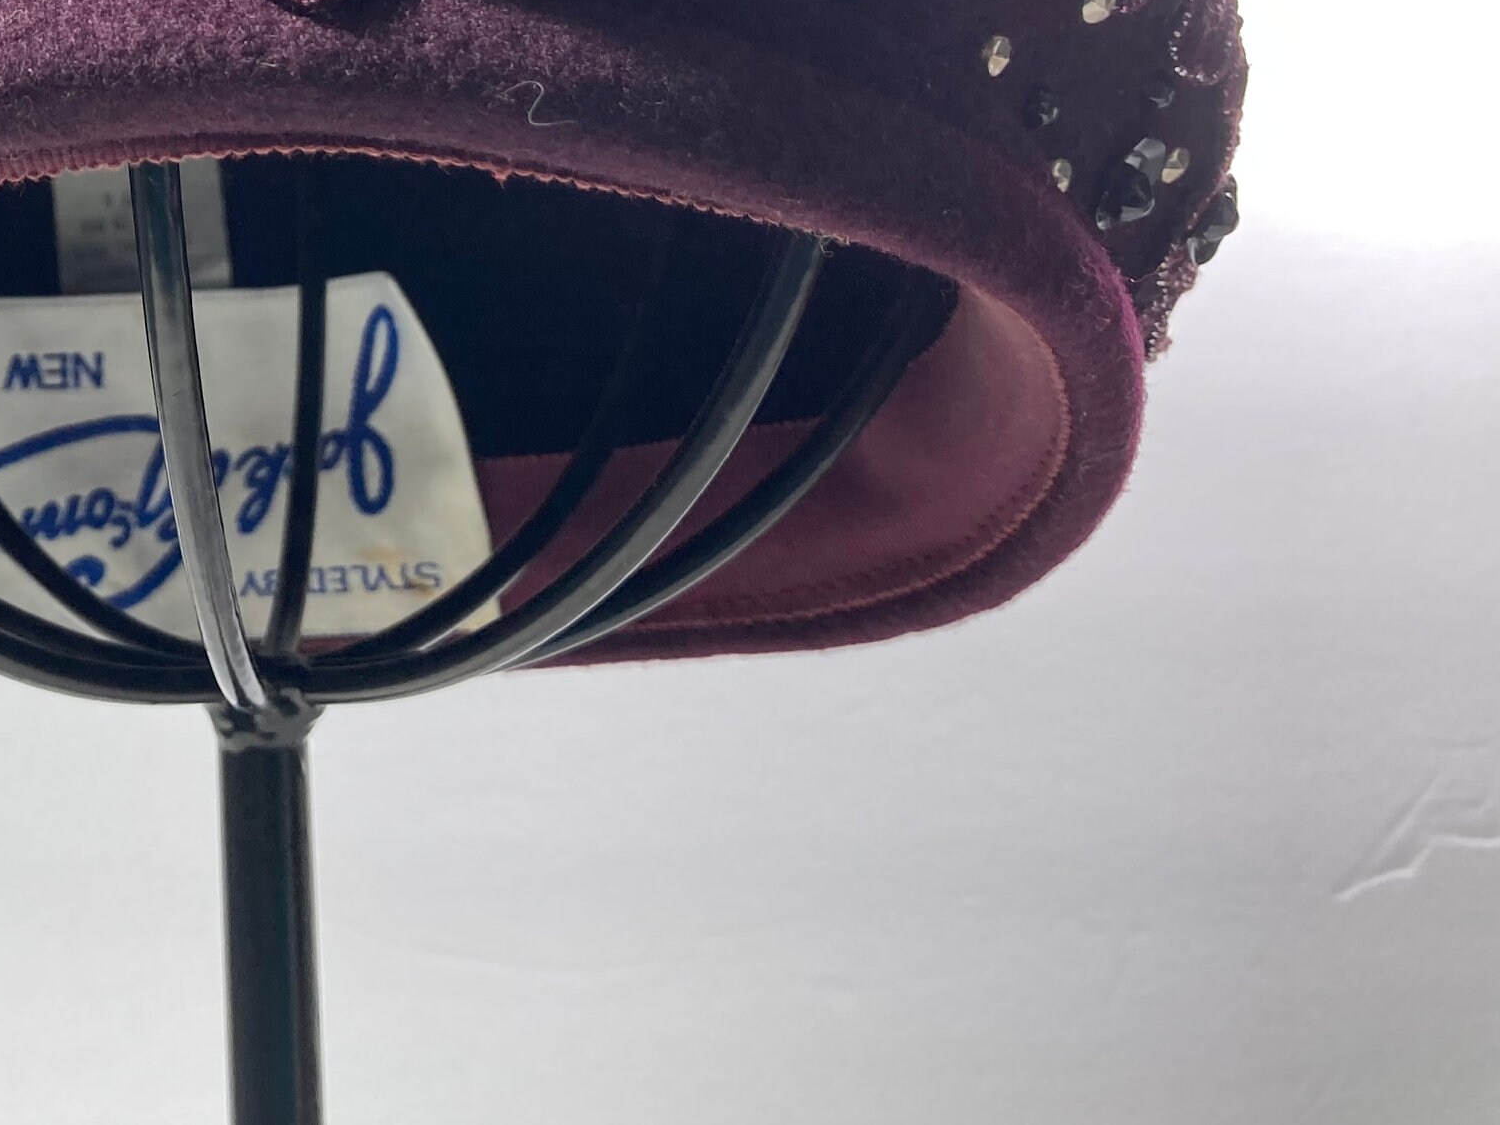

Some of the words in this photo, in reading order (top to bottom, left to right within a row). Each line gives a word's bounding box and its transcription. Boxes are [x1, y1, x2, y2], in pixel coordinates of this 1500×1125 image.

[4, 351, 106, 390] NEW
[233, 304, 401, 536] Jak
[239, 568, 280, 599] BY
[302, 562, 443, 595] STYLED
